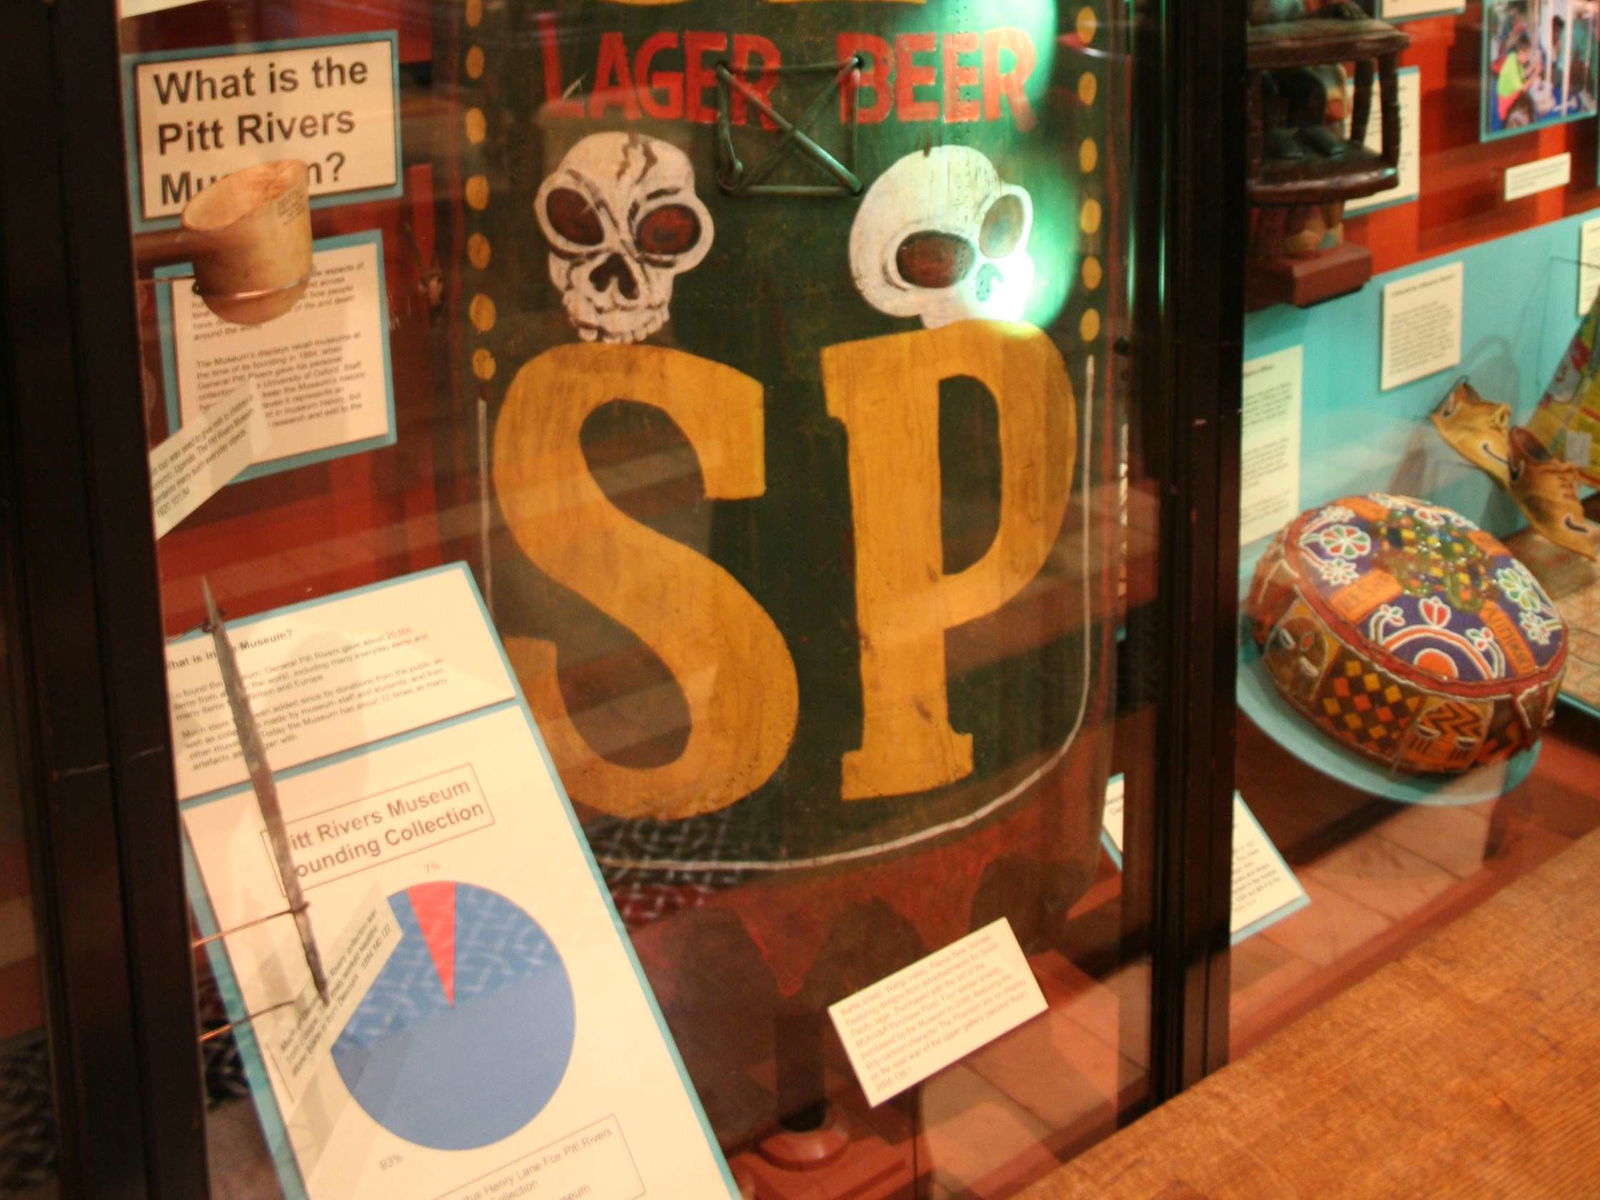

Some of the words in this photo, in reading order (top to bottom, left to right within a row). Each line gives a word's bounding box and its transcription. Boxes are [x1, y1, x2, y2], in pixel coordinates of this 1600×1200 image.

[153, 65, 256, 106] What
[267, 61, 300, 95] is
[311, 54, 369, 90] the
[537, 13, 782, 131] LAGER
[836, 27, 1038, 133] BEER
[157, 119, 225, 156] Pitt
[237, 108, 356, 148] Rivers
[493, 319, 1077, 820] SP
[239, 627, 293, 651] Museum?
[290, 831, 314, 852] itt
[316, 807, 385, 844] Rivers
[386, 779, 472, 821] Museum
[297, 836, 382, 878] ounding
[384, 801, 485, 848] Collection
